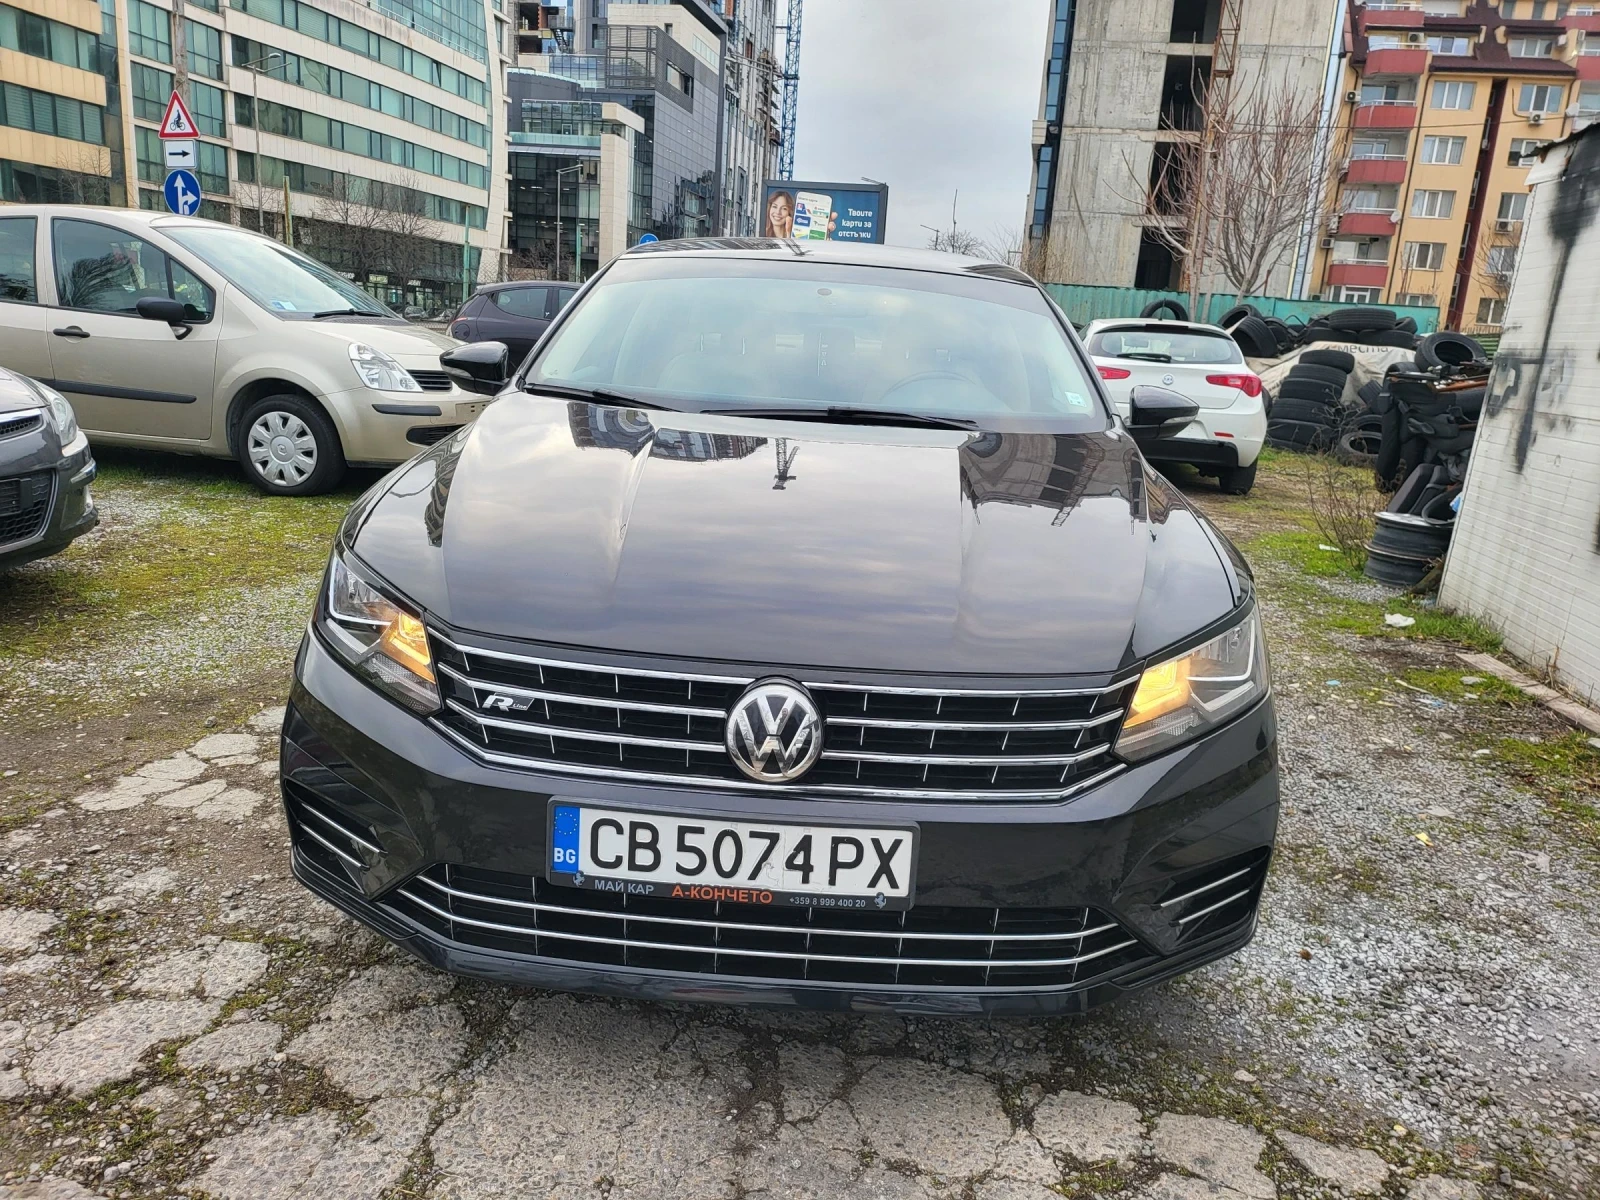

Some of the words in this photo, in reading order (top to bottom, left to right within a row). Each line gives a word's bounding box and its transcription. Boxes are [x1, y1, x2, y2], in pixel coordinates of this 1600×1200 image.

[848, 208, 873, 217] Твоите
[841, 219, 863, 228] карти
[553, 847, 577, 865] BG
[594, 879, 625, 893] МАЙ
[627, 883, 655, 895] КАР
[671, 884, 773, 904] А-КОНЧЕТО
[789, 896, 810, 905] +359
[812, 897, 818, 906] 8
[819, 898, 836, 906] 999
[837, 899, 853, 907] 400
[855, 899, 866, 908] 20
